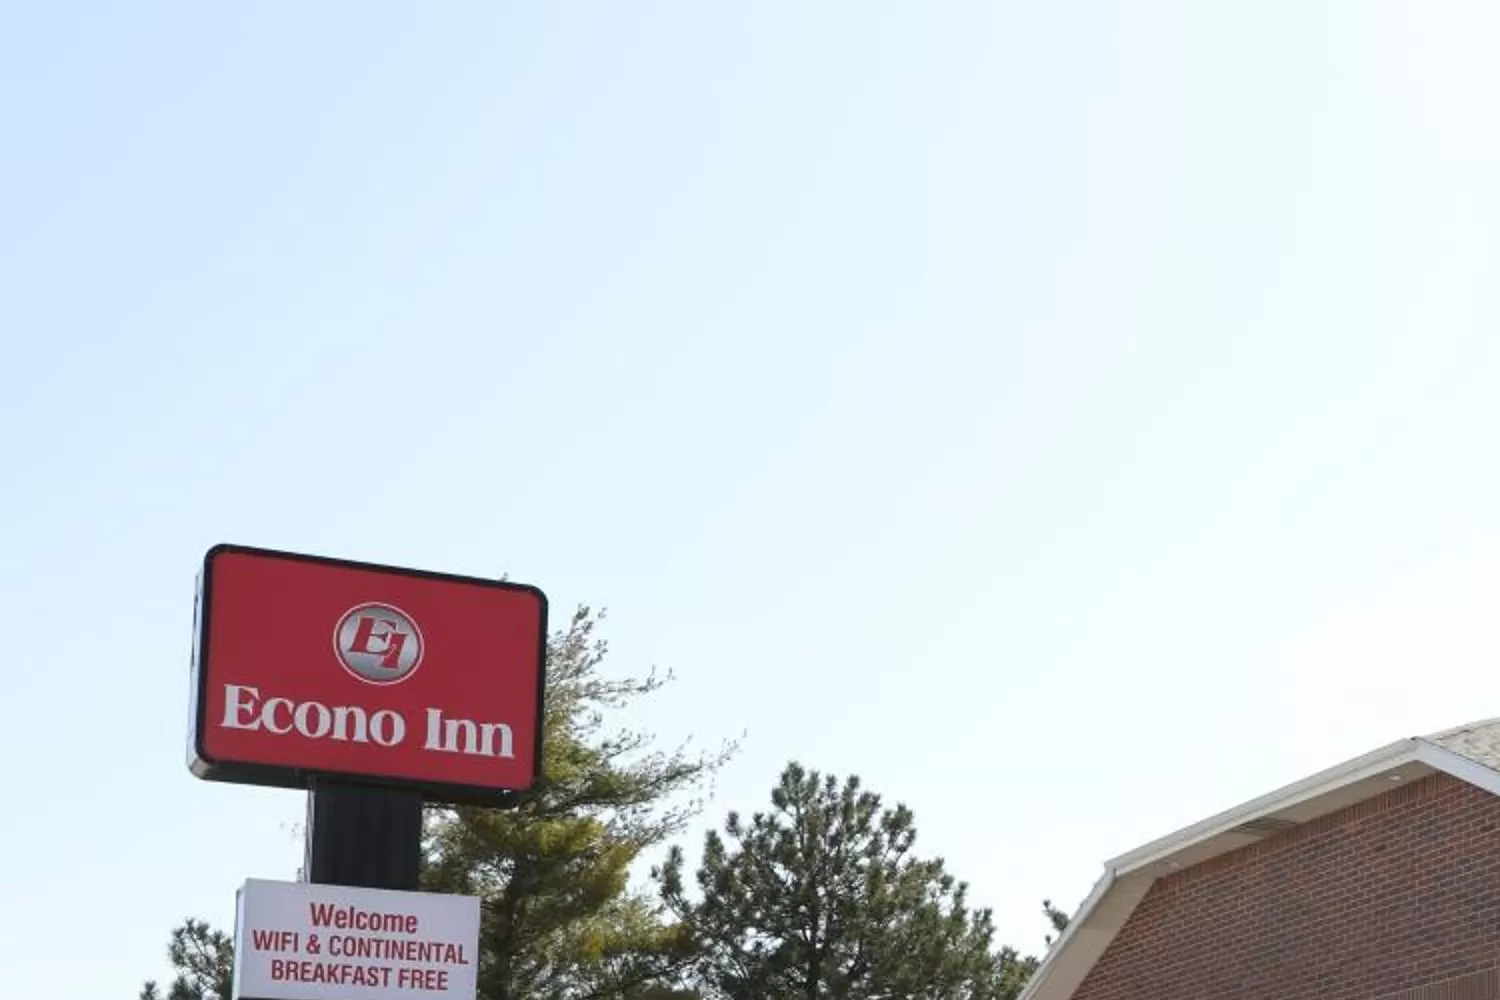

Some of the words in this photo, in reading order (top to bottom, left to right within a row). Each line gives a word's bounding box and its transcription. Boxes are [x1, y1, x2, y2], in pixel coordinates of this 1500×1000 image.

[220, 683, 406, 747] Econo
[423, 707, 515, 759] Inn
[310, 902, 418, 933] Welcome
[253, 929, 299, 952] WIFI
[306, 934, 321, 955] &
[329, 935, 469, 964] CONTINENTAL
[271, 959, 392, 988] BREAKFAST
[399, 968, 449, 991] FREE
